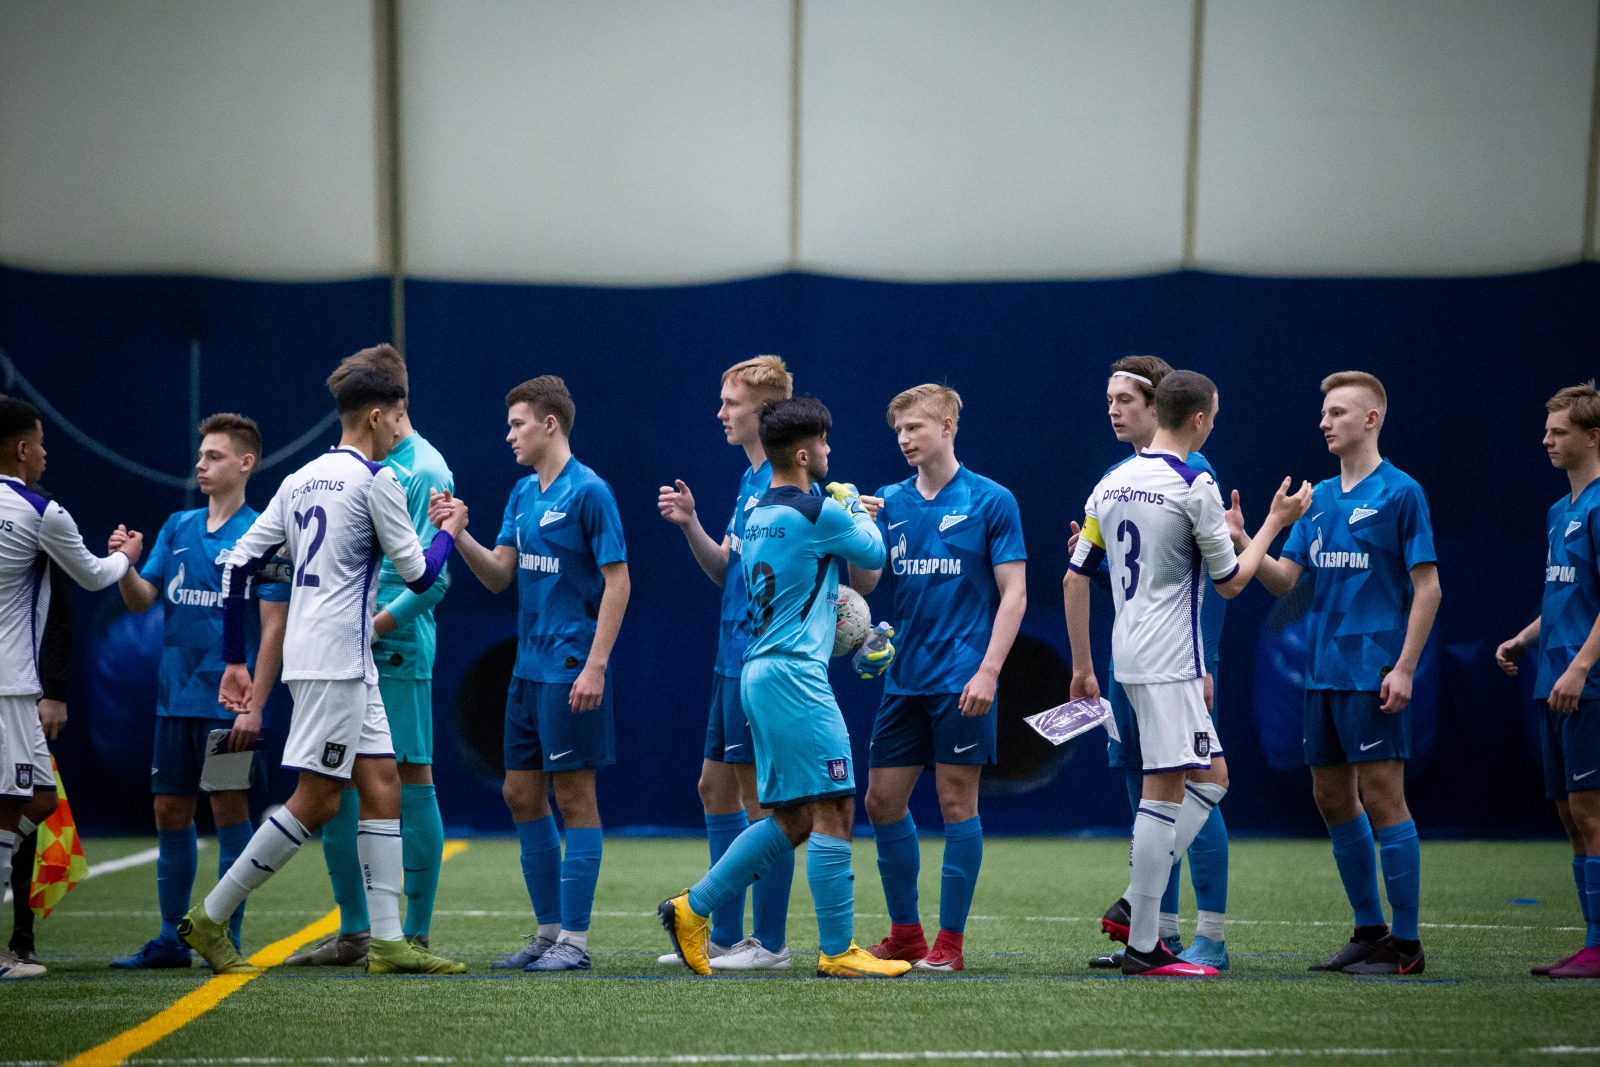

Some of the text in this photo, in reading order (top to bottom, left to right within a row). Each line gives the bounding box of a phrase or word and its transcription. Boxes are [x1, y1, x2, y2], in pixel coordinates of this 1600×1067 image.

[1101, 486, 1165, 505] proximus
[745, 525, 785, 541] oximus
[907, 558, 961, 575] ГАЗПРОМ
[1117, 519, 1141, 601] 3
[1319, 551, 1369, 569] ГАЗПРОМ
[363, 863, 373, 891] RSCA
